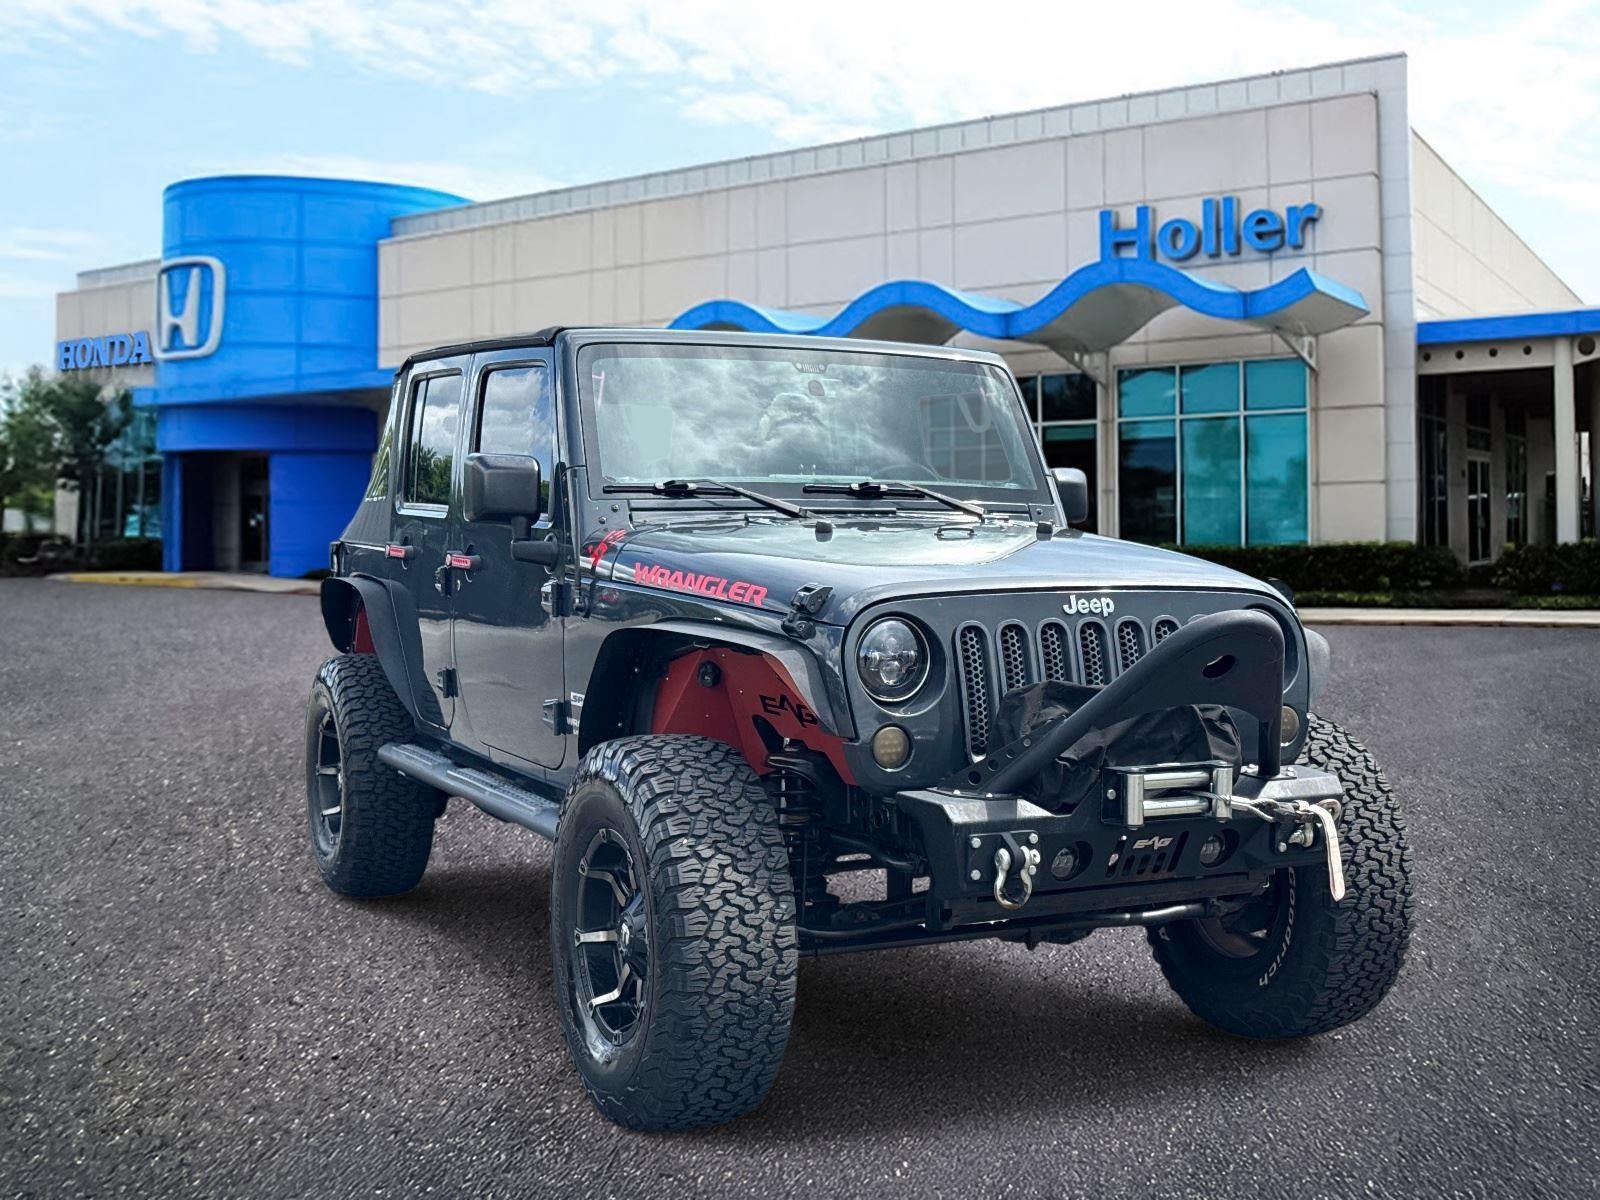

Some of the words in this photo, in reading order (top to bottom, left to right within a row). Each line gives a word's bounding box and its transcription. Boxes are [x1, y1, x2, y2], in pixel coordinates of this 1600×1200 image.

[1099, 196, 1322, 262] Holler
[57, 331, 152, 370] HONDA
[634, 562, 768, 606] WRANGLER
[1063, 594, 1114, 617] Jeep
